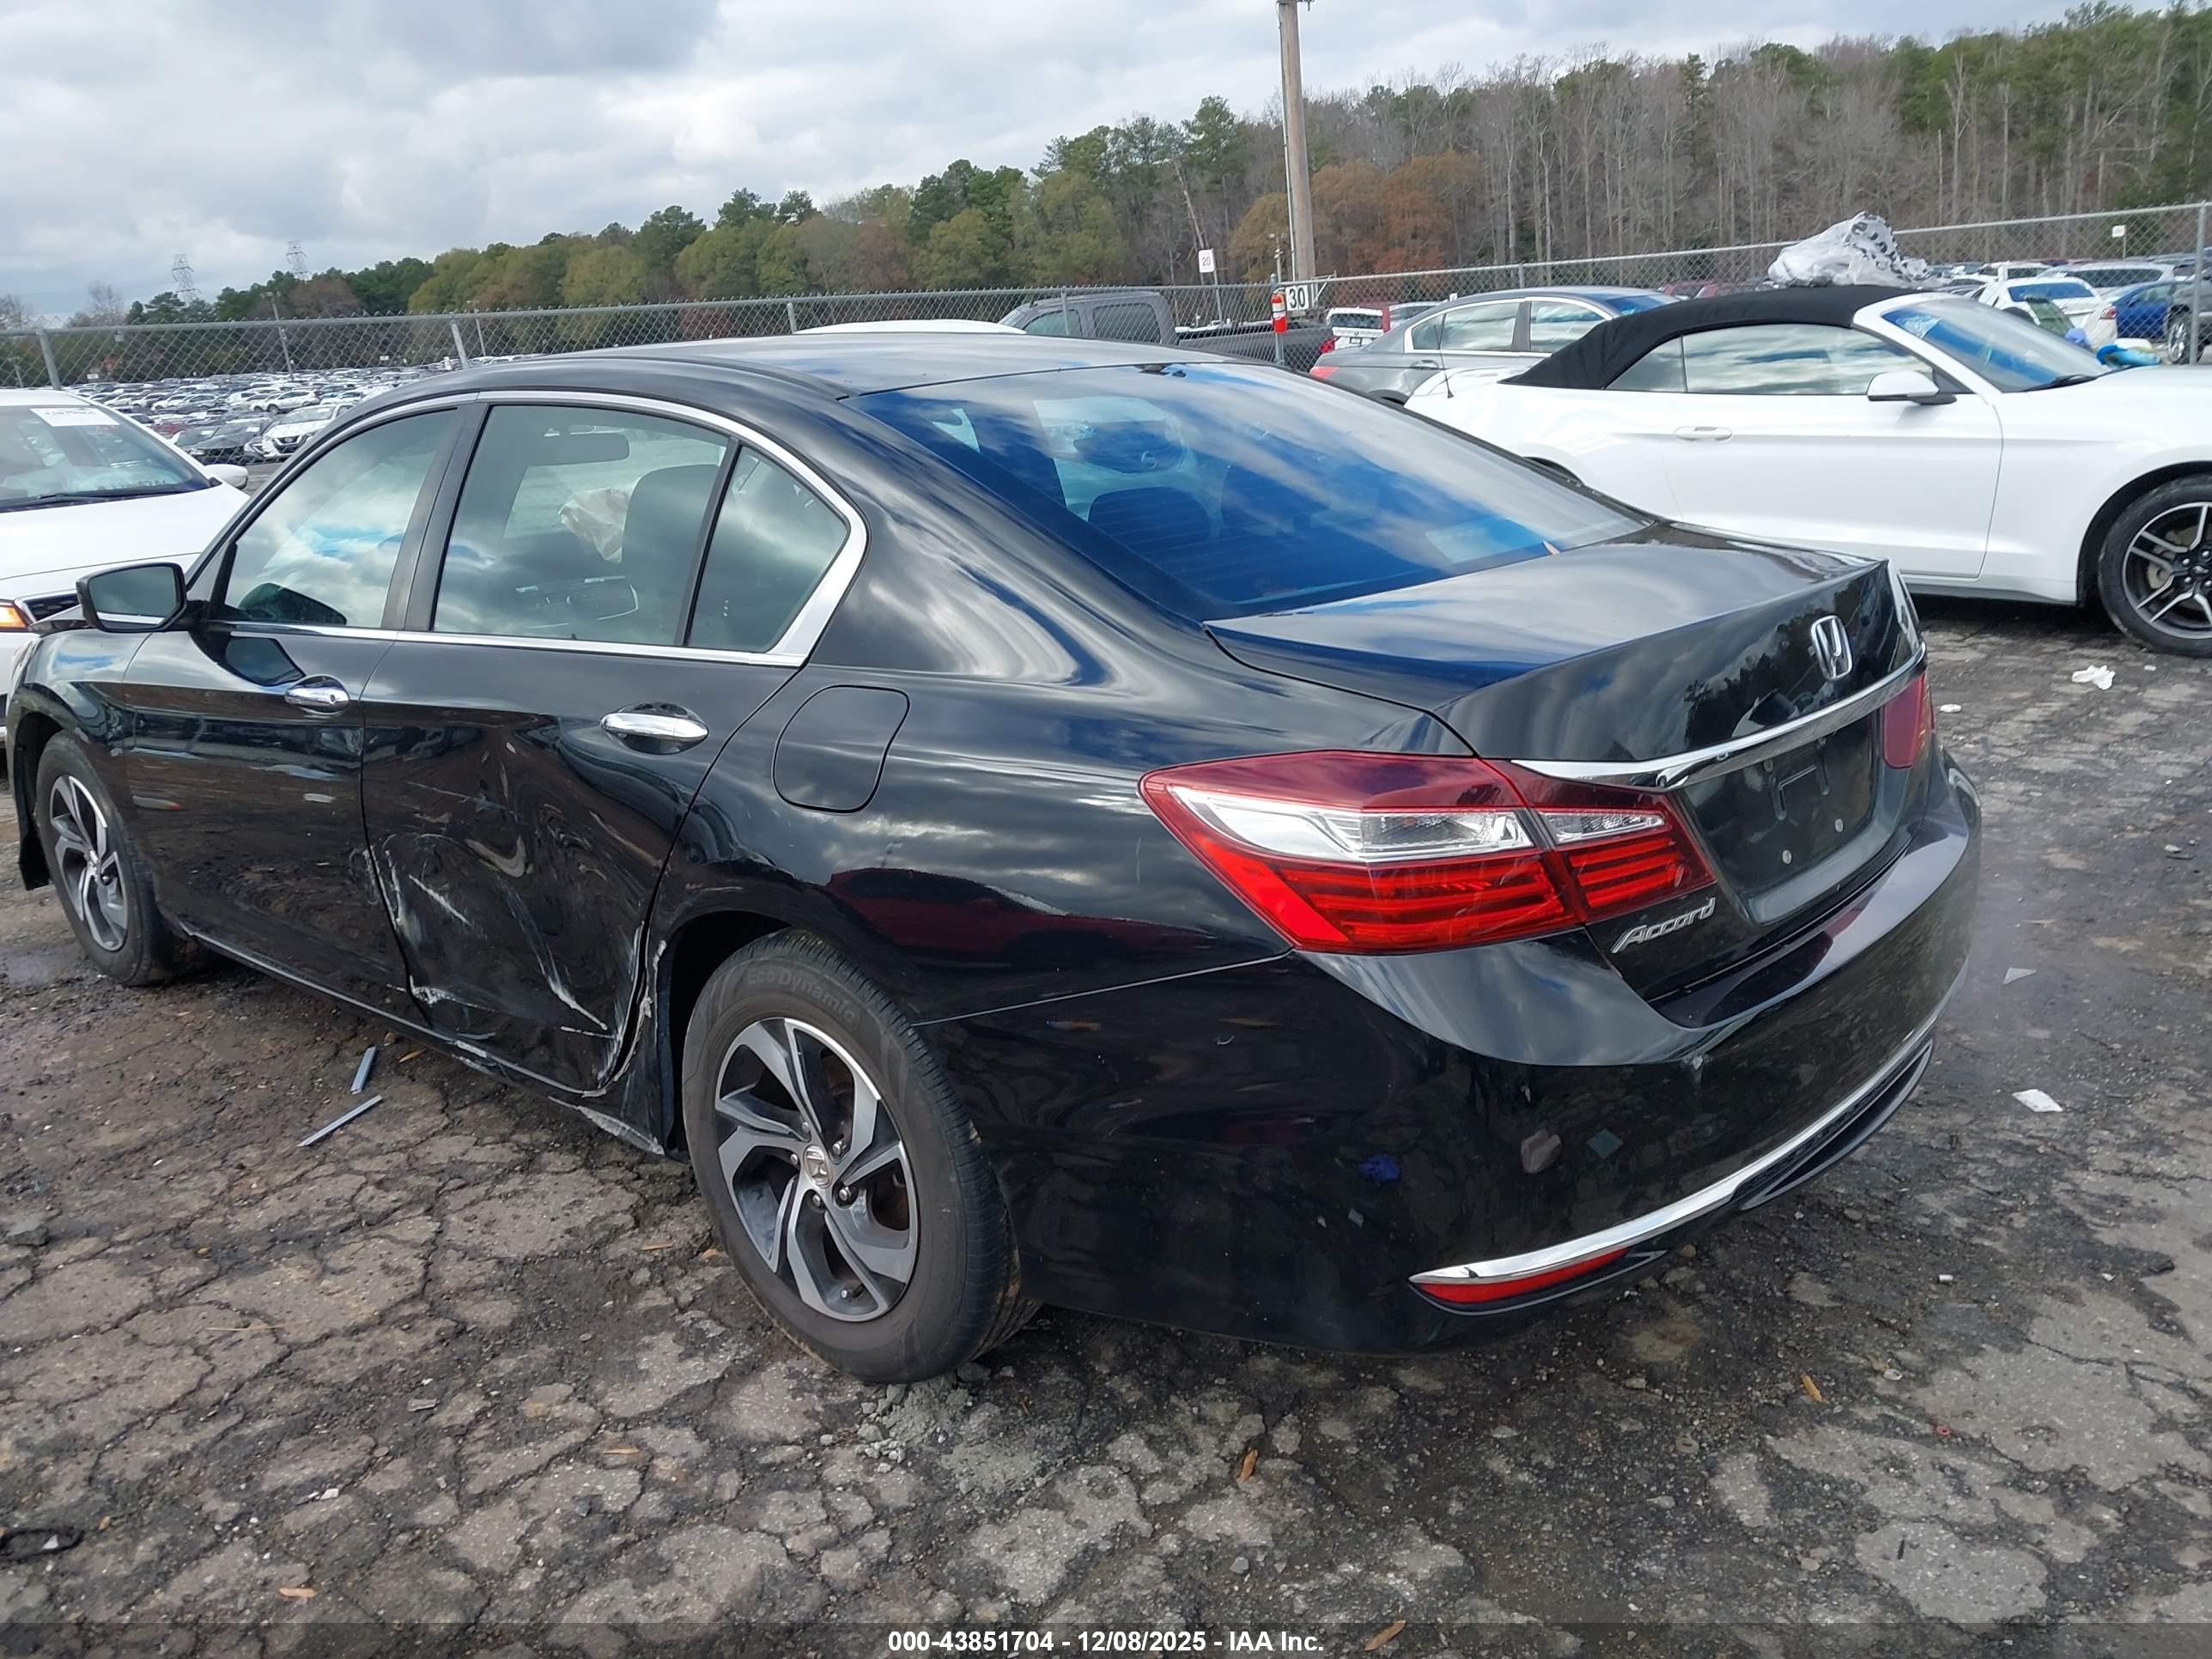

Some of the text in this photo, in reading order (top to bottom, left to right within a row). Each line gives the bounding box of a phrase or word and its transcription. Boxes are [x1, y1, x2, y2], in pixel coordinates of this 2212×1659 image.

[1202, 257, 1211, 266] 20
[1289, 288, 1305, 308] 30
[1610, 897, 1716, 953] Accord
